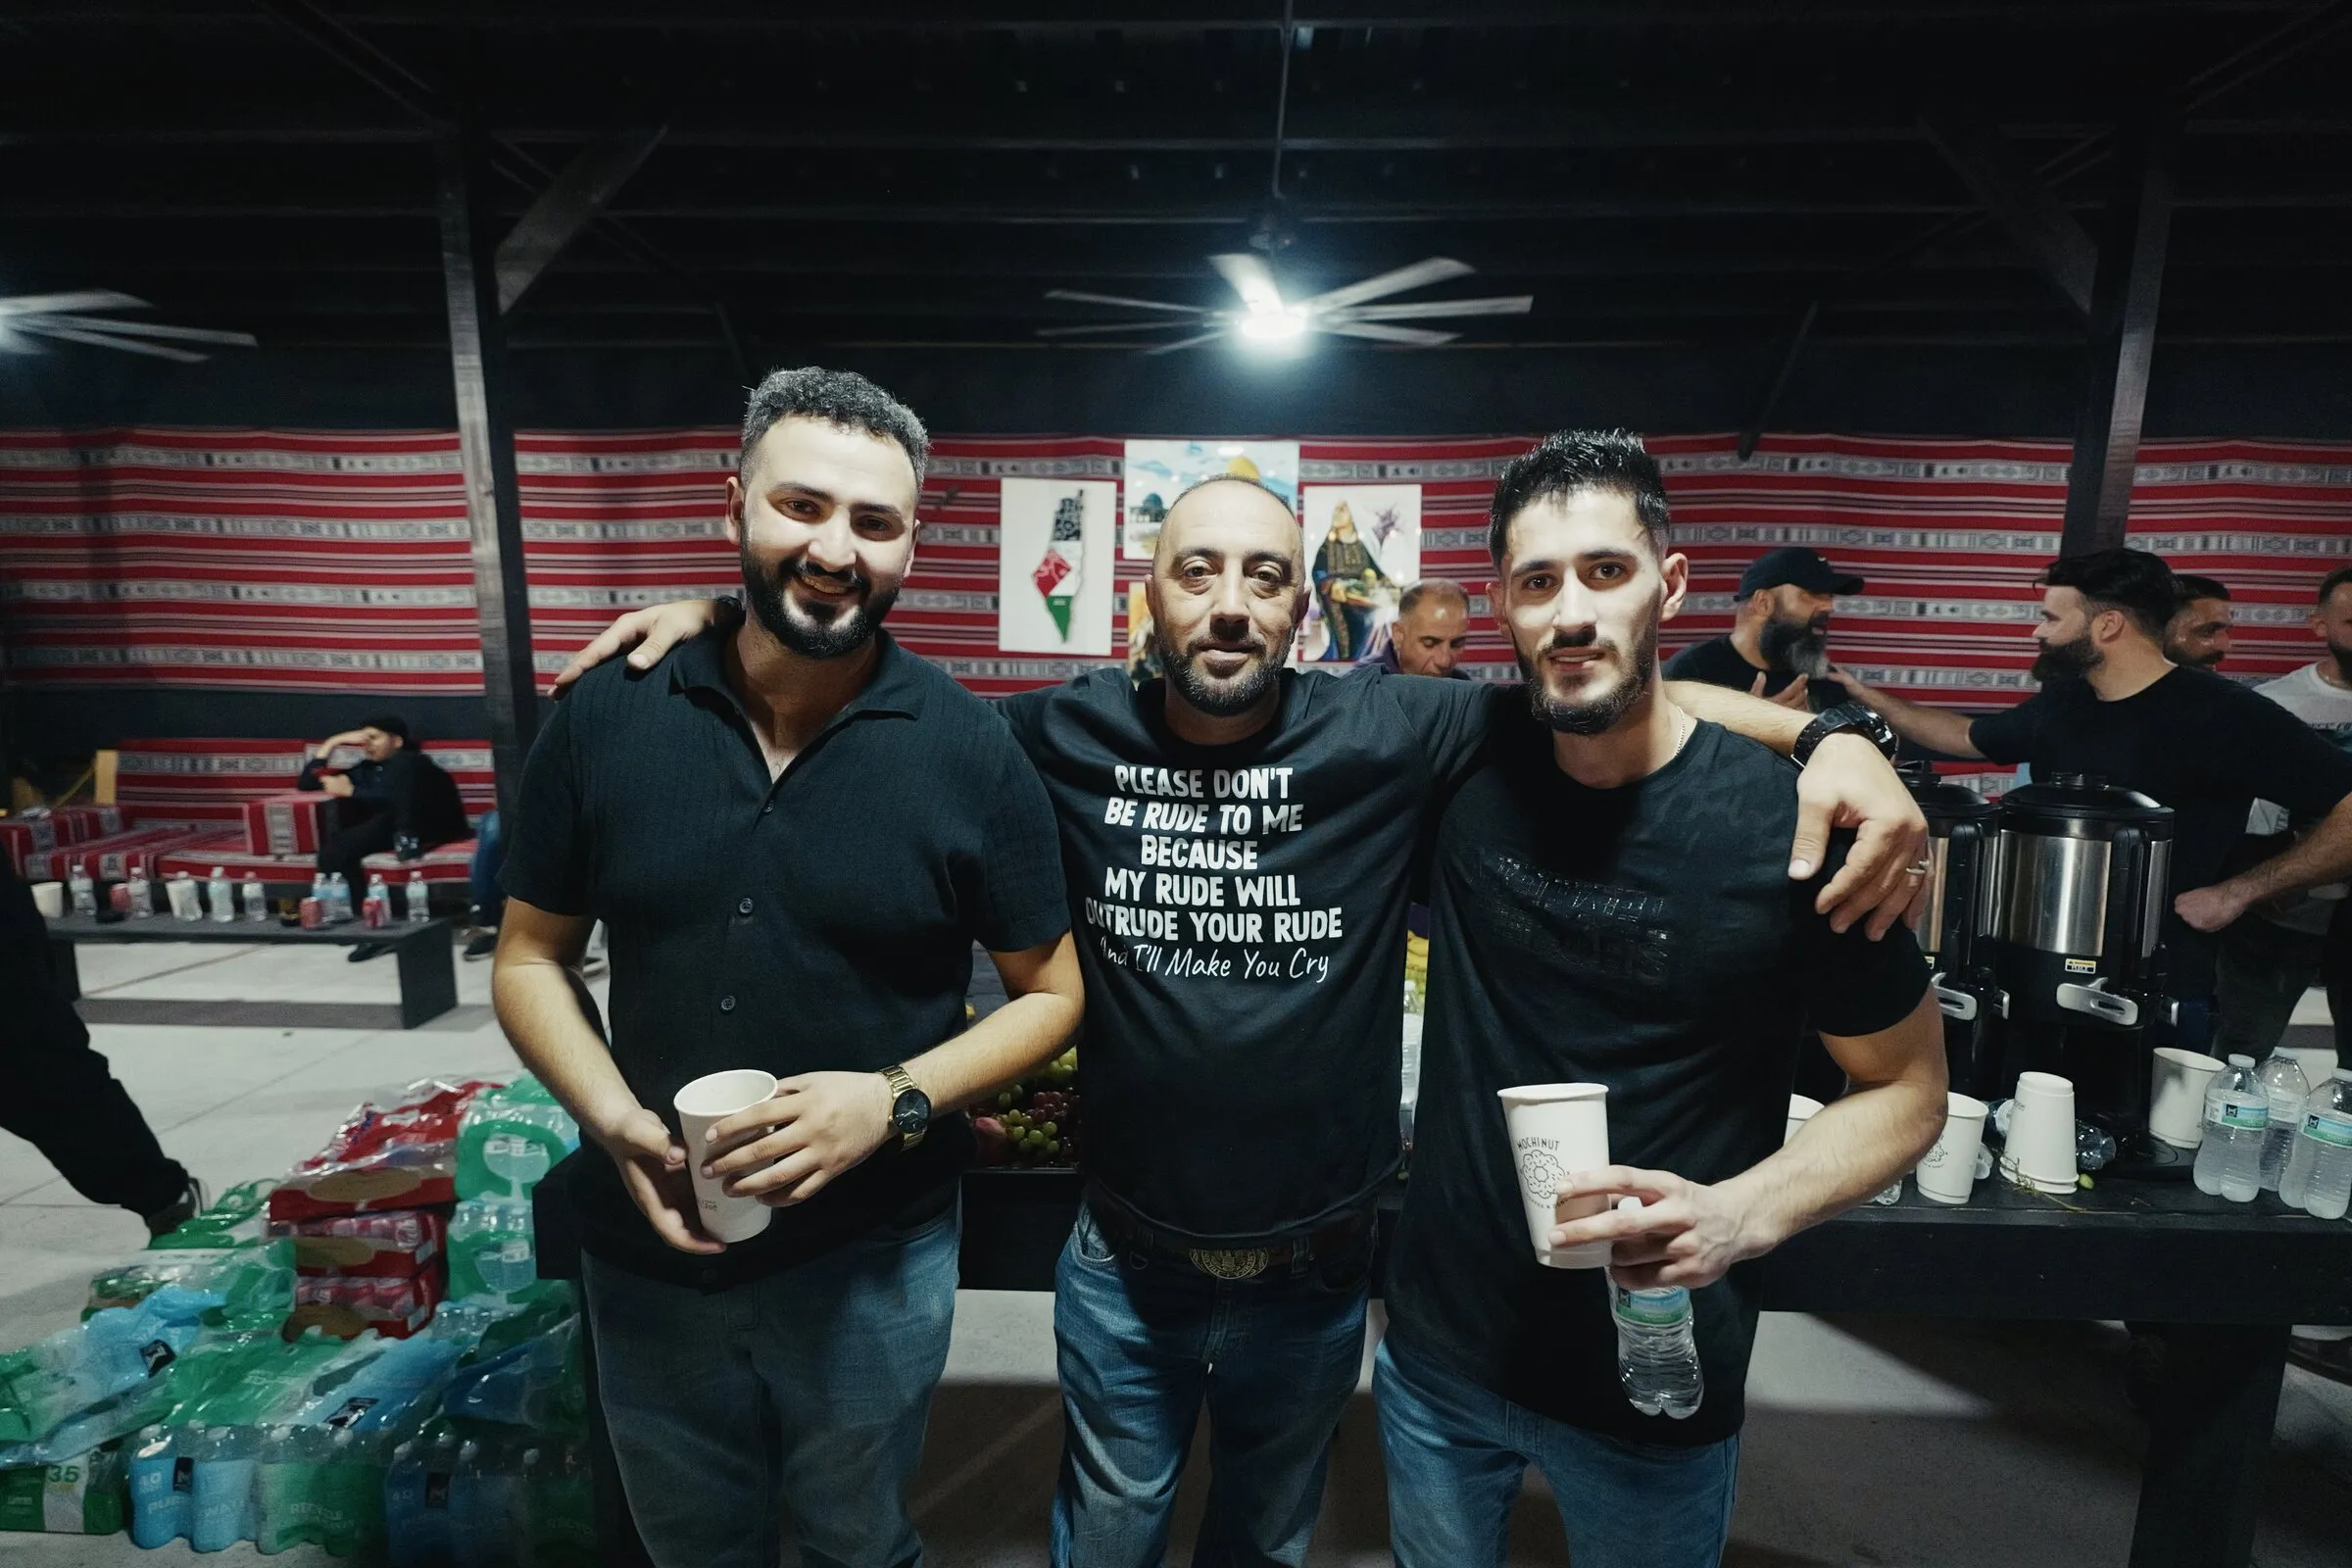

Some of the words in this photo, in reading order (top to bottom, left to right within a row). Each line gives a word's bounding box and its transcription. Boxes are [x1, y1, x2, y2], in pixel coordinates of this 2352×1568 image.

[1114, 765, 1204, 799] PLEASE
[1213, 767, 1293, 799] DON'T
[1104, 797, 1139, 827] BE
[1142, 801, 1209, 833] RUDE
[1219, 805, 1251, 835] TO
[1262, 804, 1304, 835] ME
[1141, 834, 1258, 870] BECAUSE
[1104, 866, 1147, 902] MY
[1155, 872, 1225, 907] RUDE
[1235, 874, 1300, 907] WILL
[1085, 897, 1179, 941] OUTRUDE
[1189, 911, 1264, 943] YOUR
[1274, 906, 1344, 943] RUDE
[1133, 943, 1163, 973] I'll
[1164, 948, 1232, 978] Make
[1244, 949, 1280, 979] You
[1289, 947, 1330, 984] Cry
[1516, 1136, 1560, 1152] MOCHINUT
[49, 1464, 80, 1484] 35
